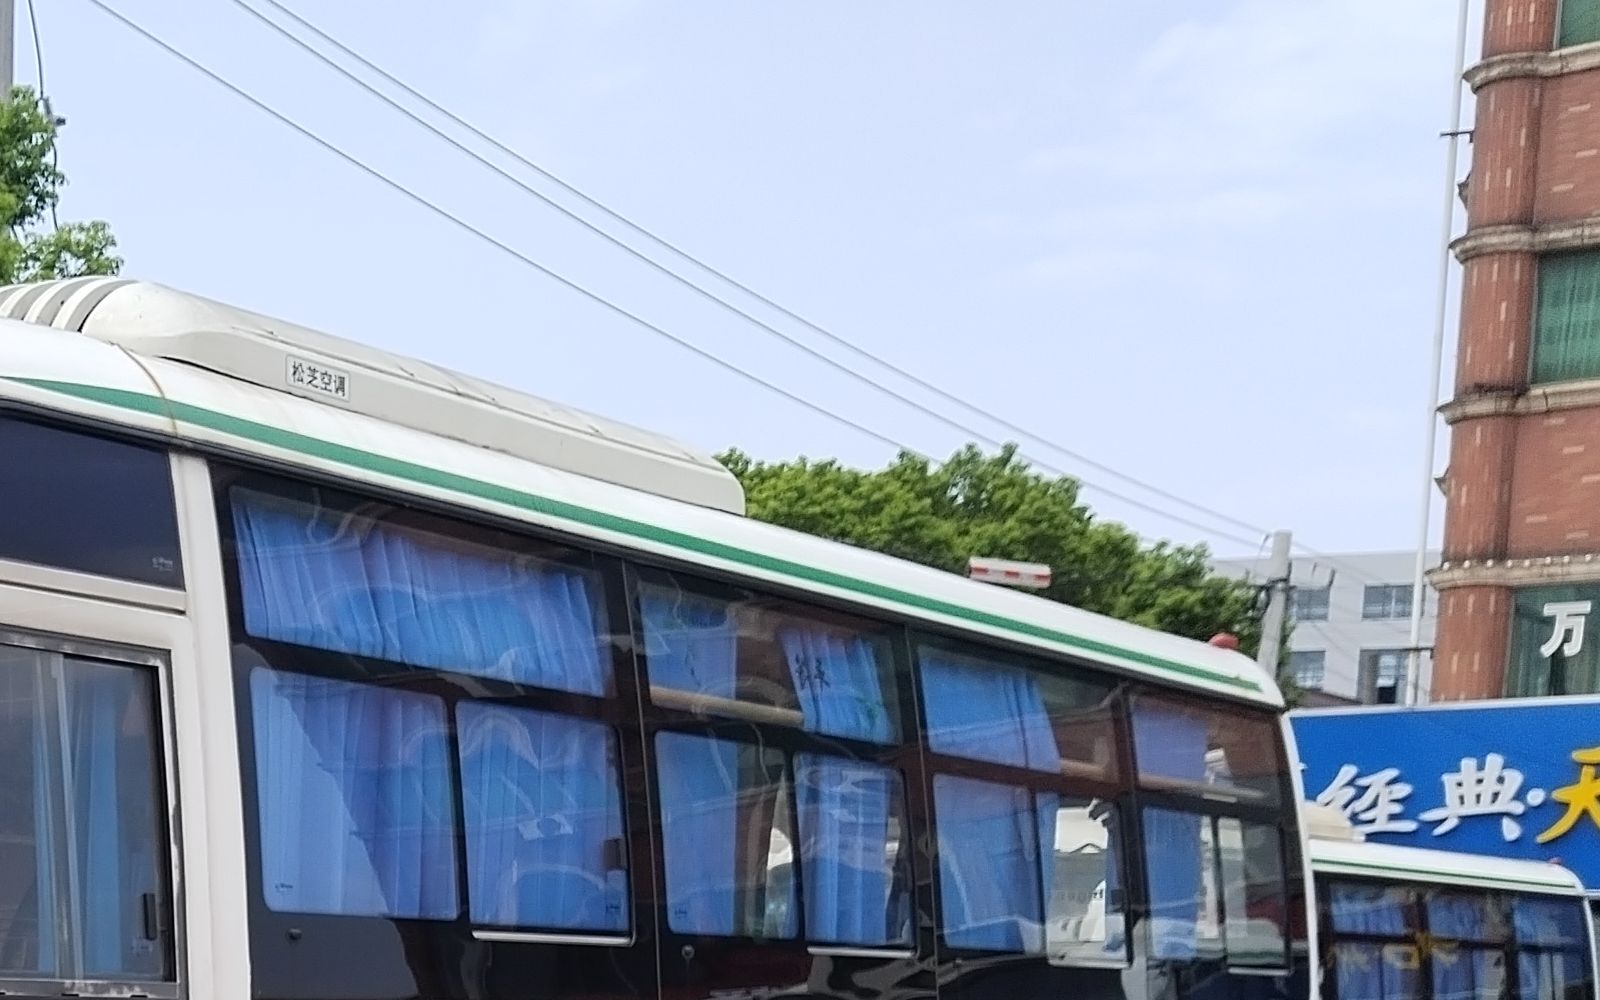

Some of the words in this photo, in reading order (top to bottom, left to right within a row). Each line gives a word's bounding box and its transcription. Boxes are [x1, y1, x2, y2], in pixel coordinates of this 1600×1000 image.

[291, 360, 346, 398] 松芝空调
[1540, 600, 1592, 658] 万
